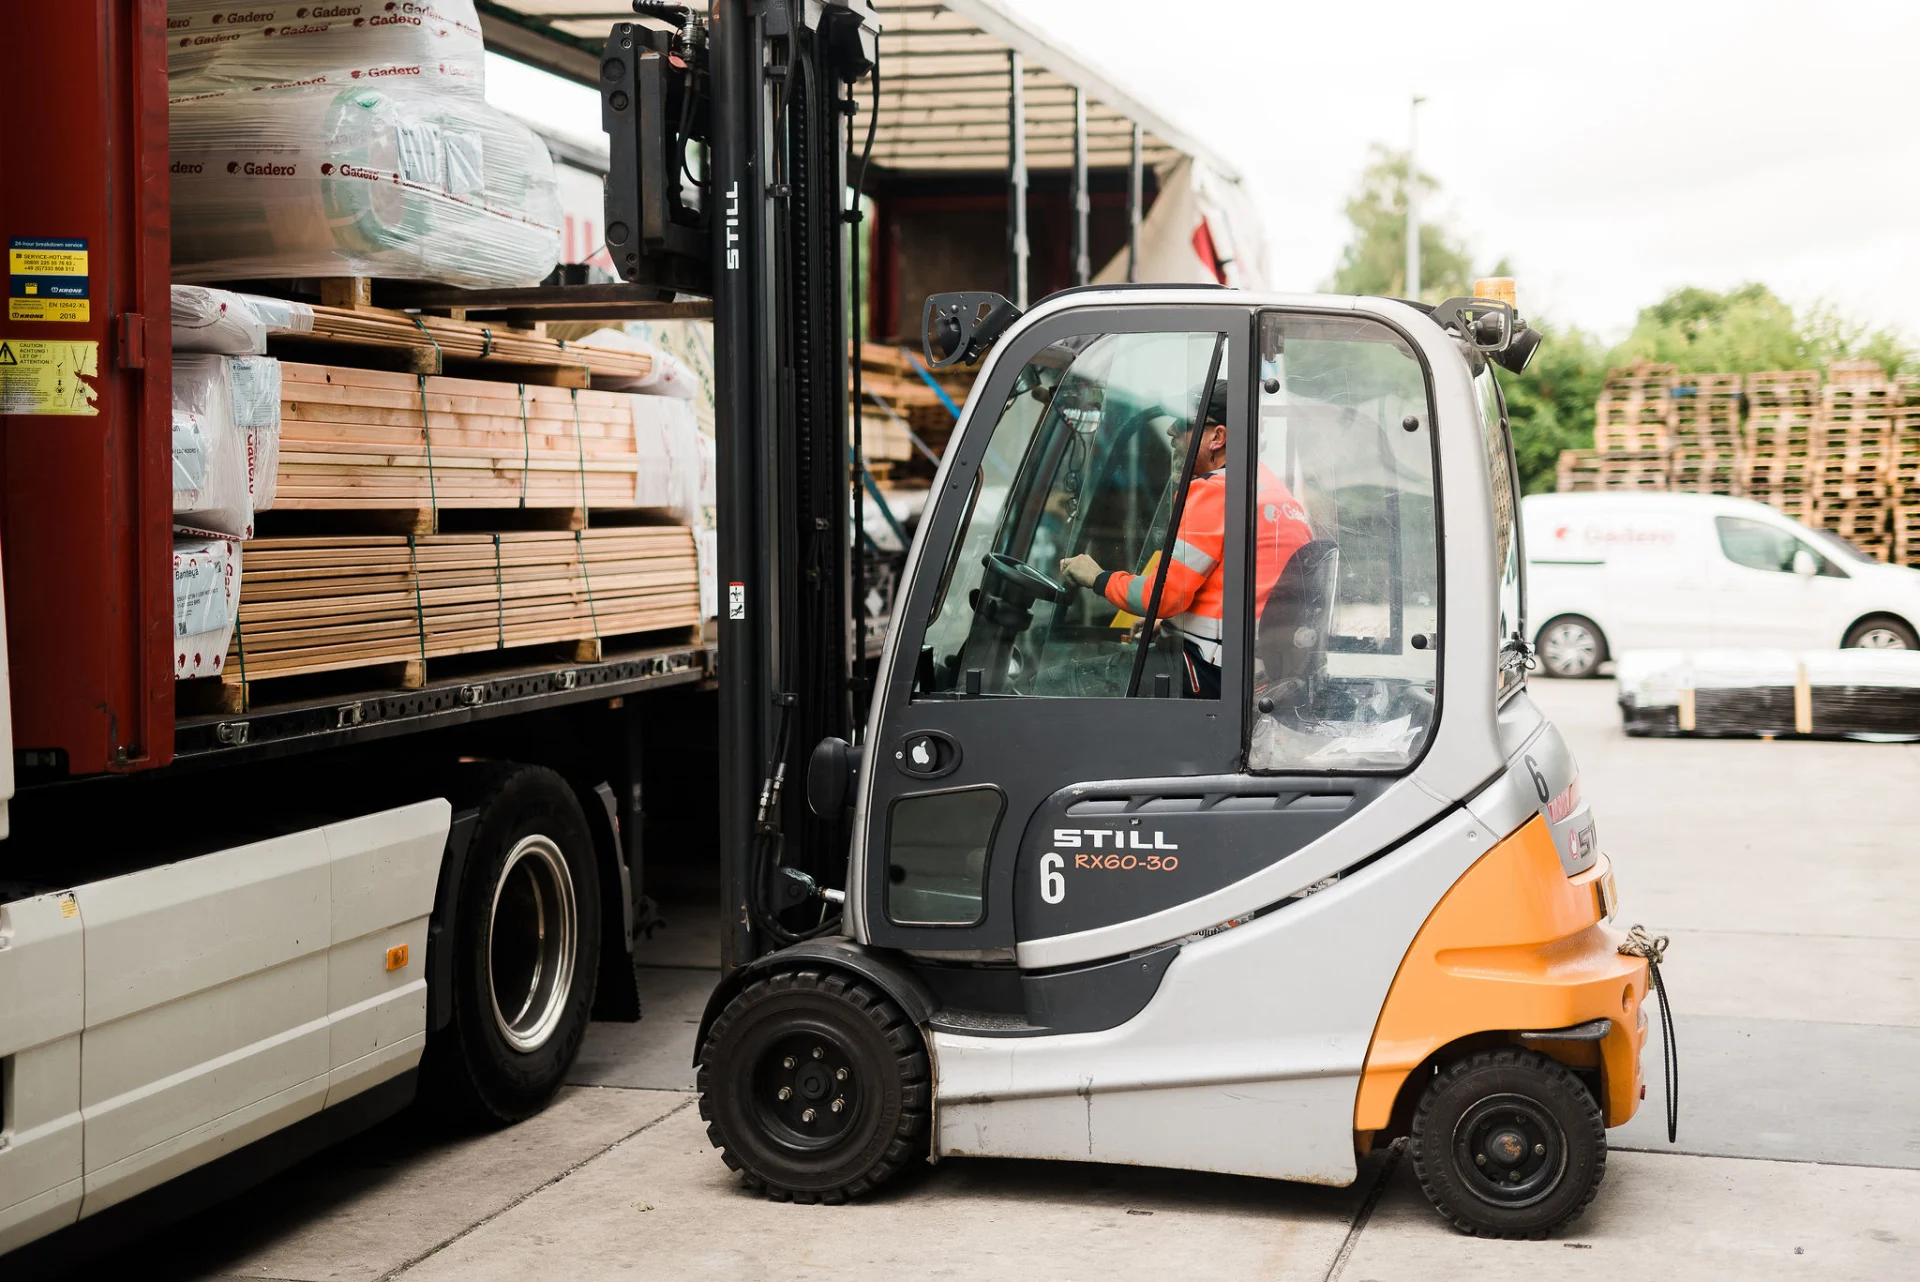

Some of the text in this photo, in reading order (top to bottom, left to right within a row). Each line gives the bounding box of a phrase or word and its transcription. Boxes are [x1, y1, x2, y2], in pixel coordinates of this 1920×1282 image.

[227, 12, 274, 24] Gadero
[312, 7, 361, 18] Gadero
[369, 14, 422, 26] Gadero
[280, 25, 328, 36] Gadero
[194, 33, 240, 46] Gadero
[368, 66, 420, 77] Gadero
[243, 162, 296, 176] Gadero
[725, 181, 740, 270] STILL
[1525, 754, 1550, 804] 6
[1053, 829, 1178, 850] STILL
[1074, 854, 1179, 872] RX60-30
[1040, 852, 1065, 905] 6
